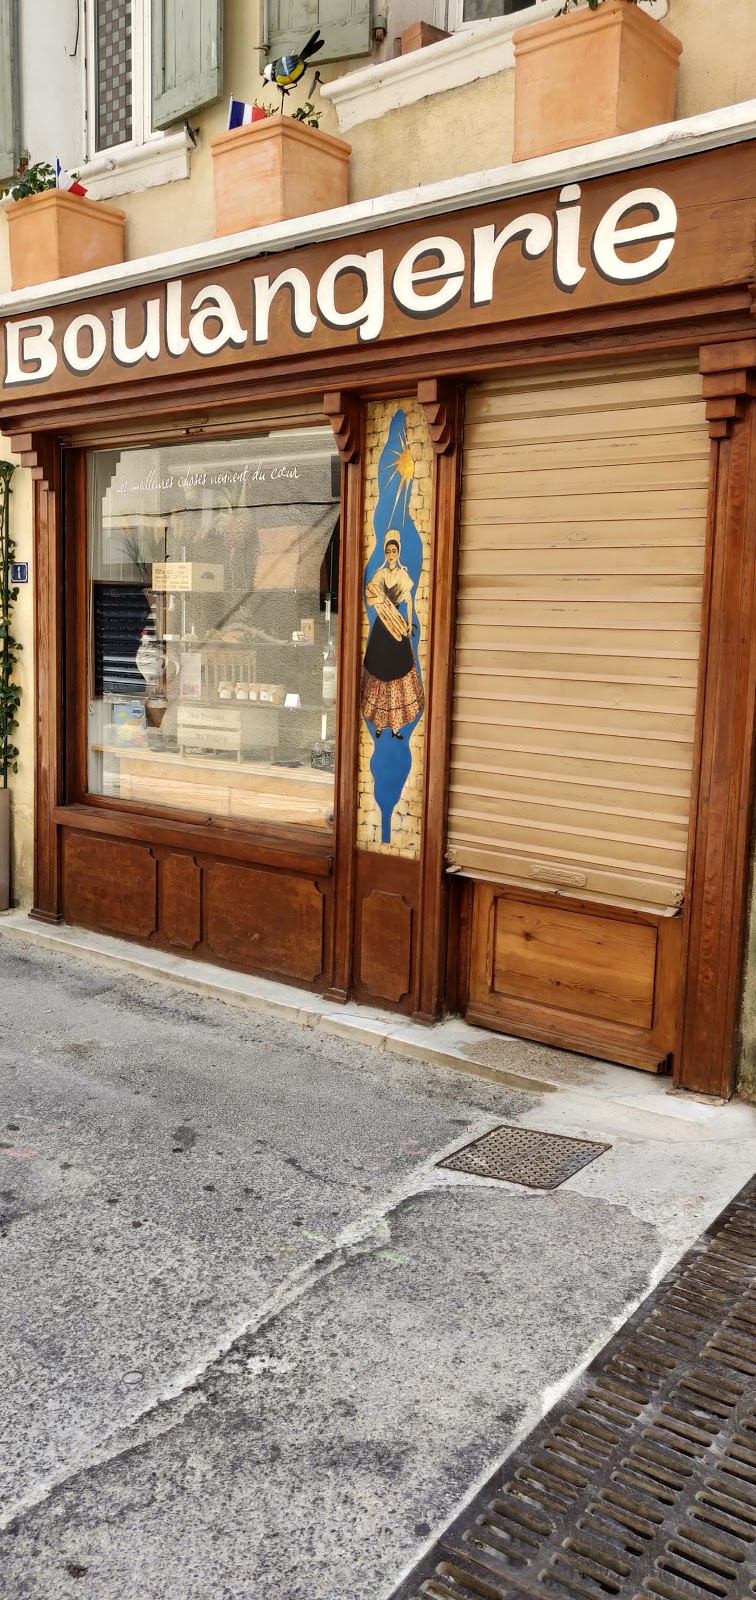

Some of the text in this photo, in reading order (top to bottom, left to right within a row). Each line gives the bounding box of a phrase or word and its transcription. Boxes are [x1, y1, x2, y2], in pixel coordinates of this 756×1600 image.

[3, 183, 679, 385] Boulangerie
[132, 469, 175, 491] meilleures
[177, 464, 208, 487] choses
[210, 464, 250, 485] viennent
[252, 461, 266, 480] du
